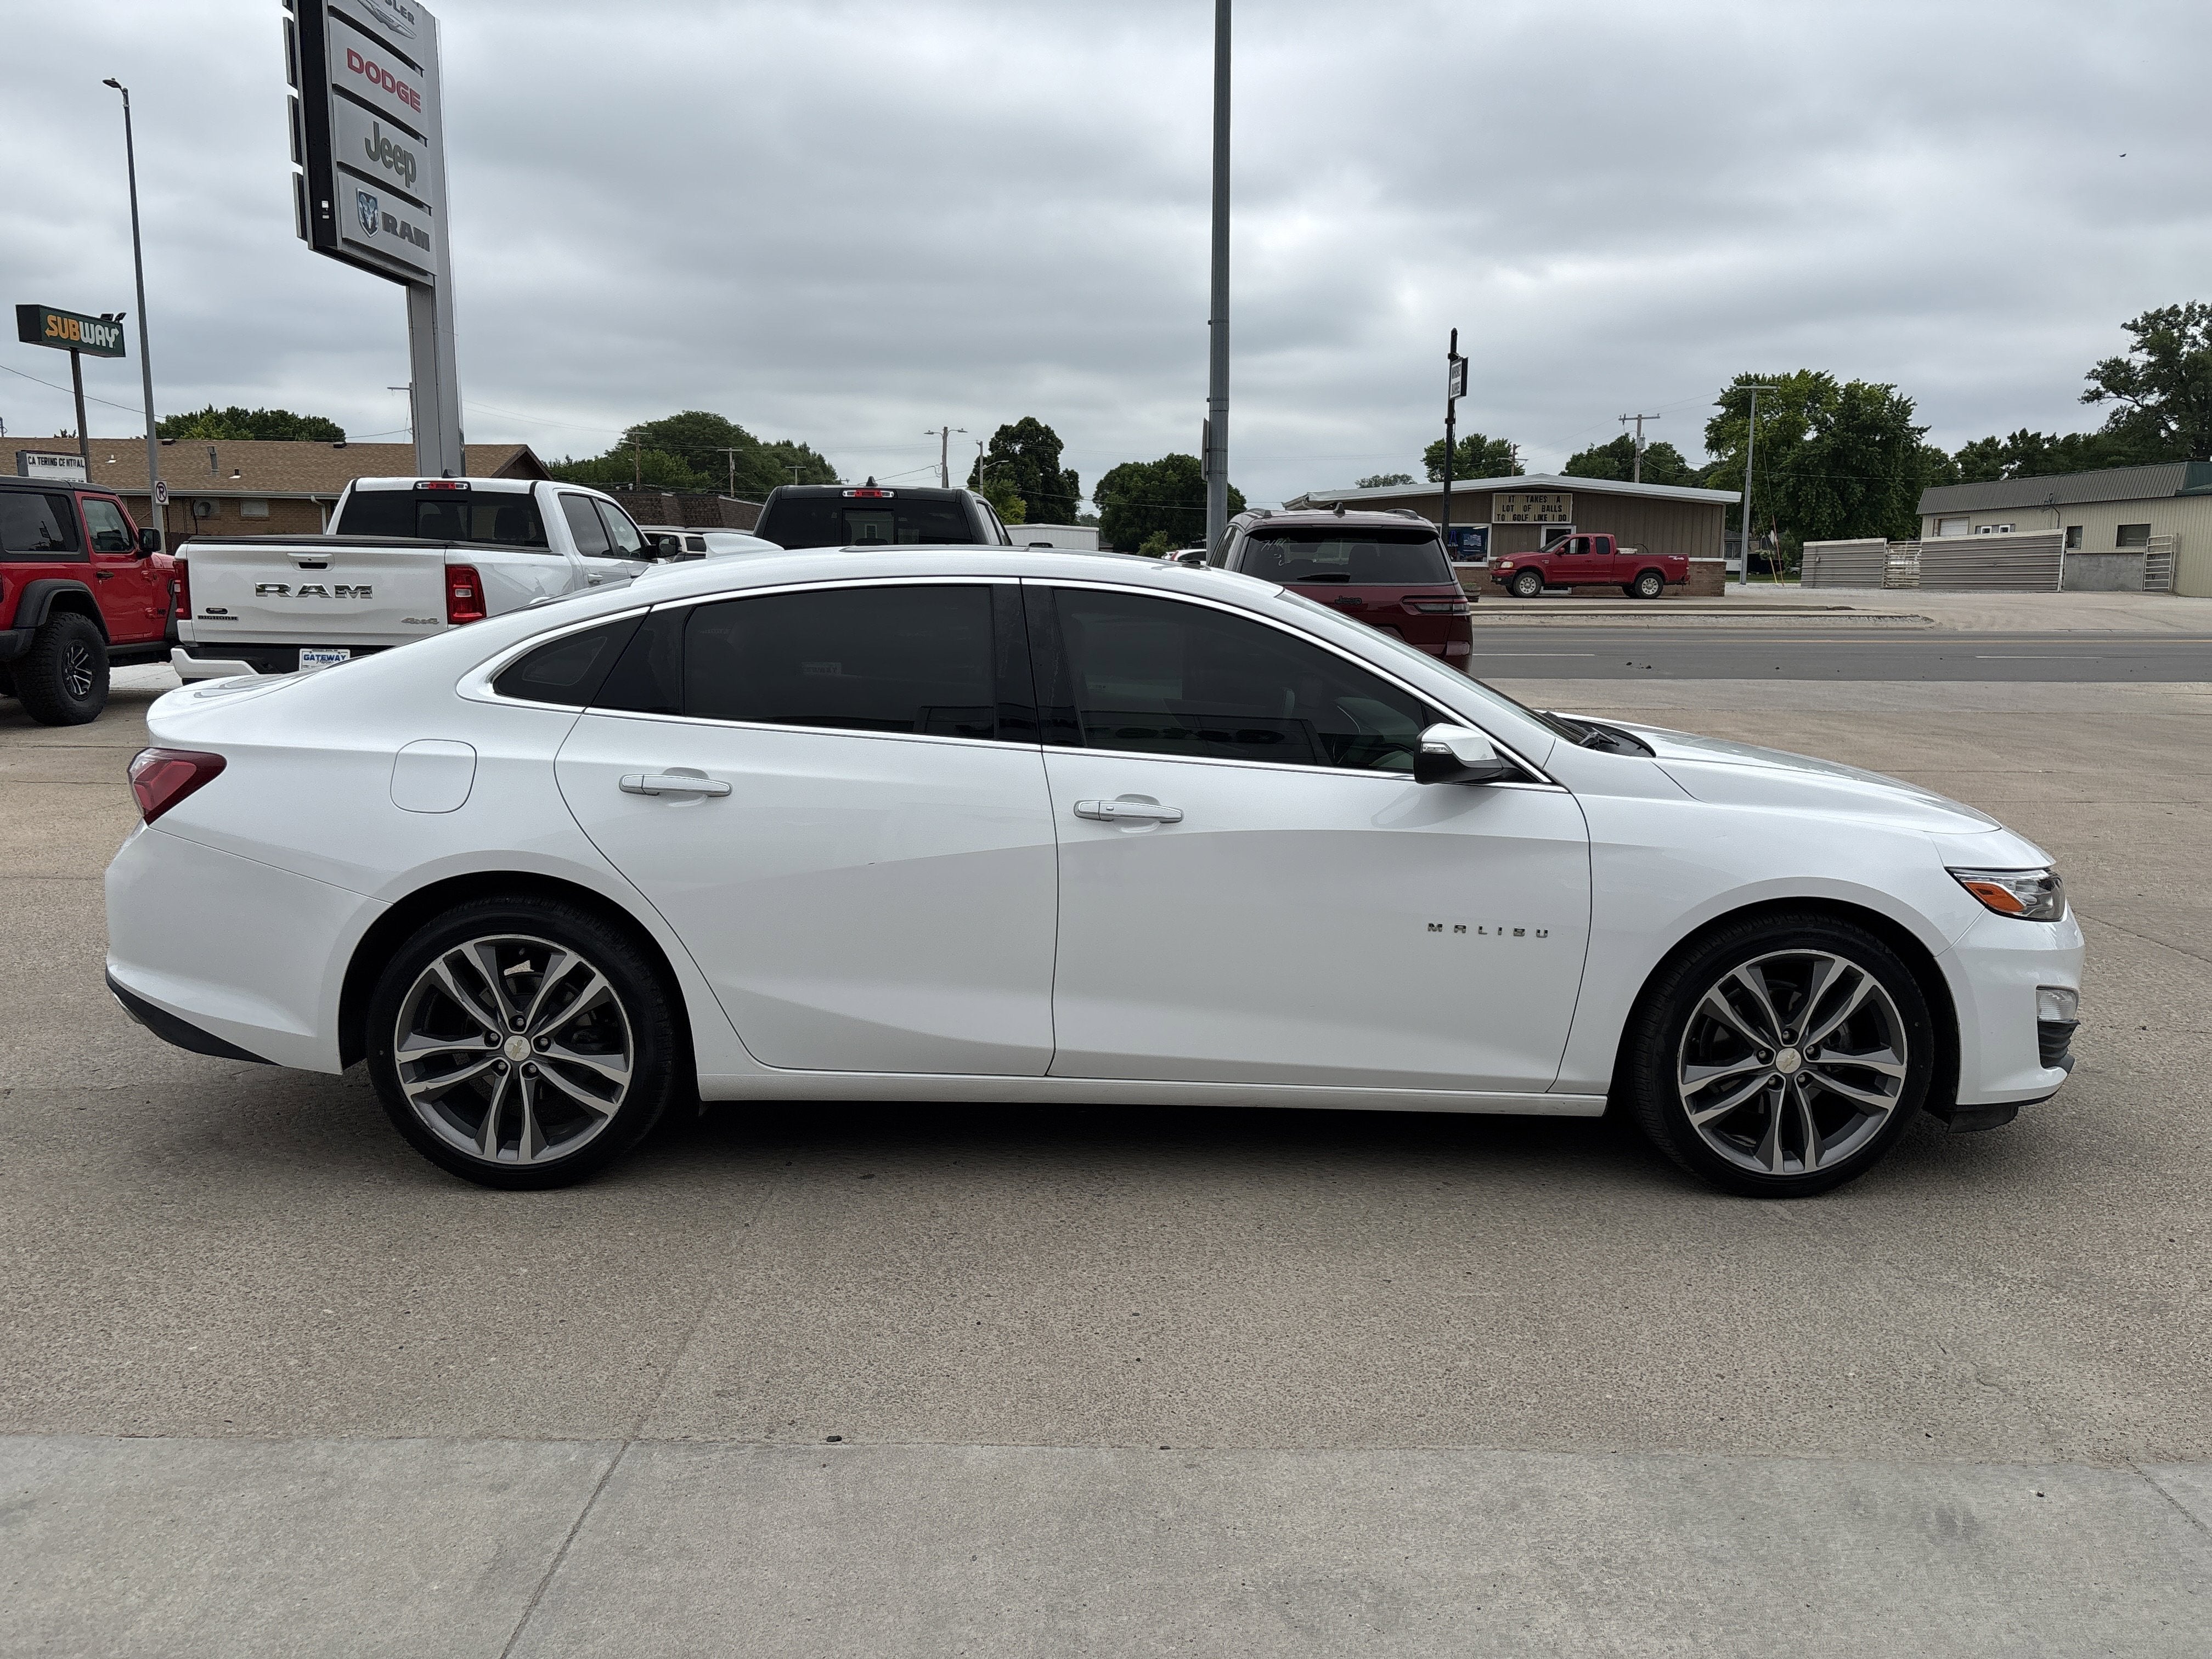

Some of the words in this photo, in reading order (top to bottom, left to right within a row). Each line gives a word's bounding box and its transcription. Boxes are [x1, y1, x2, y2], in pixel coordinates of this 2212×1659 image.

[347, 48, 421, 113] DODGE
[365, 121, 416, 188] Jeep
[381, 211, 430, 252] RAM
[46, 315, 119, 348] SUBWAY
[255, 582, 373, 599] RAM
[1334, 595, 1363, 605] Jeep
[1427, 923, 1548, 938] MALIBU
